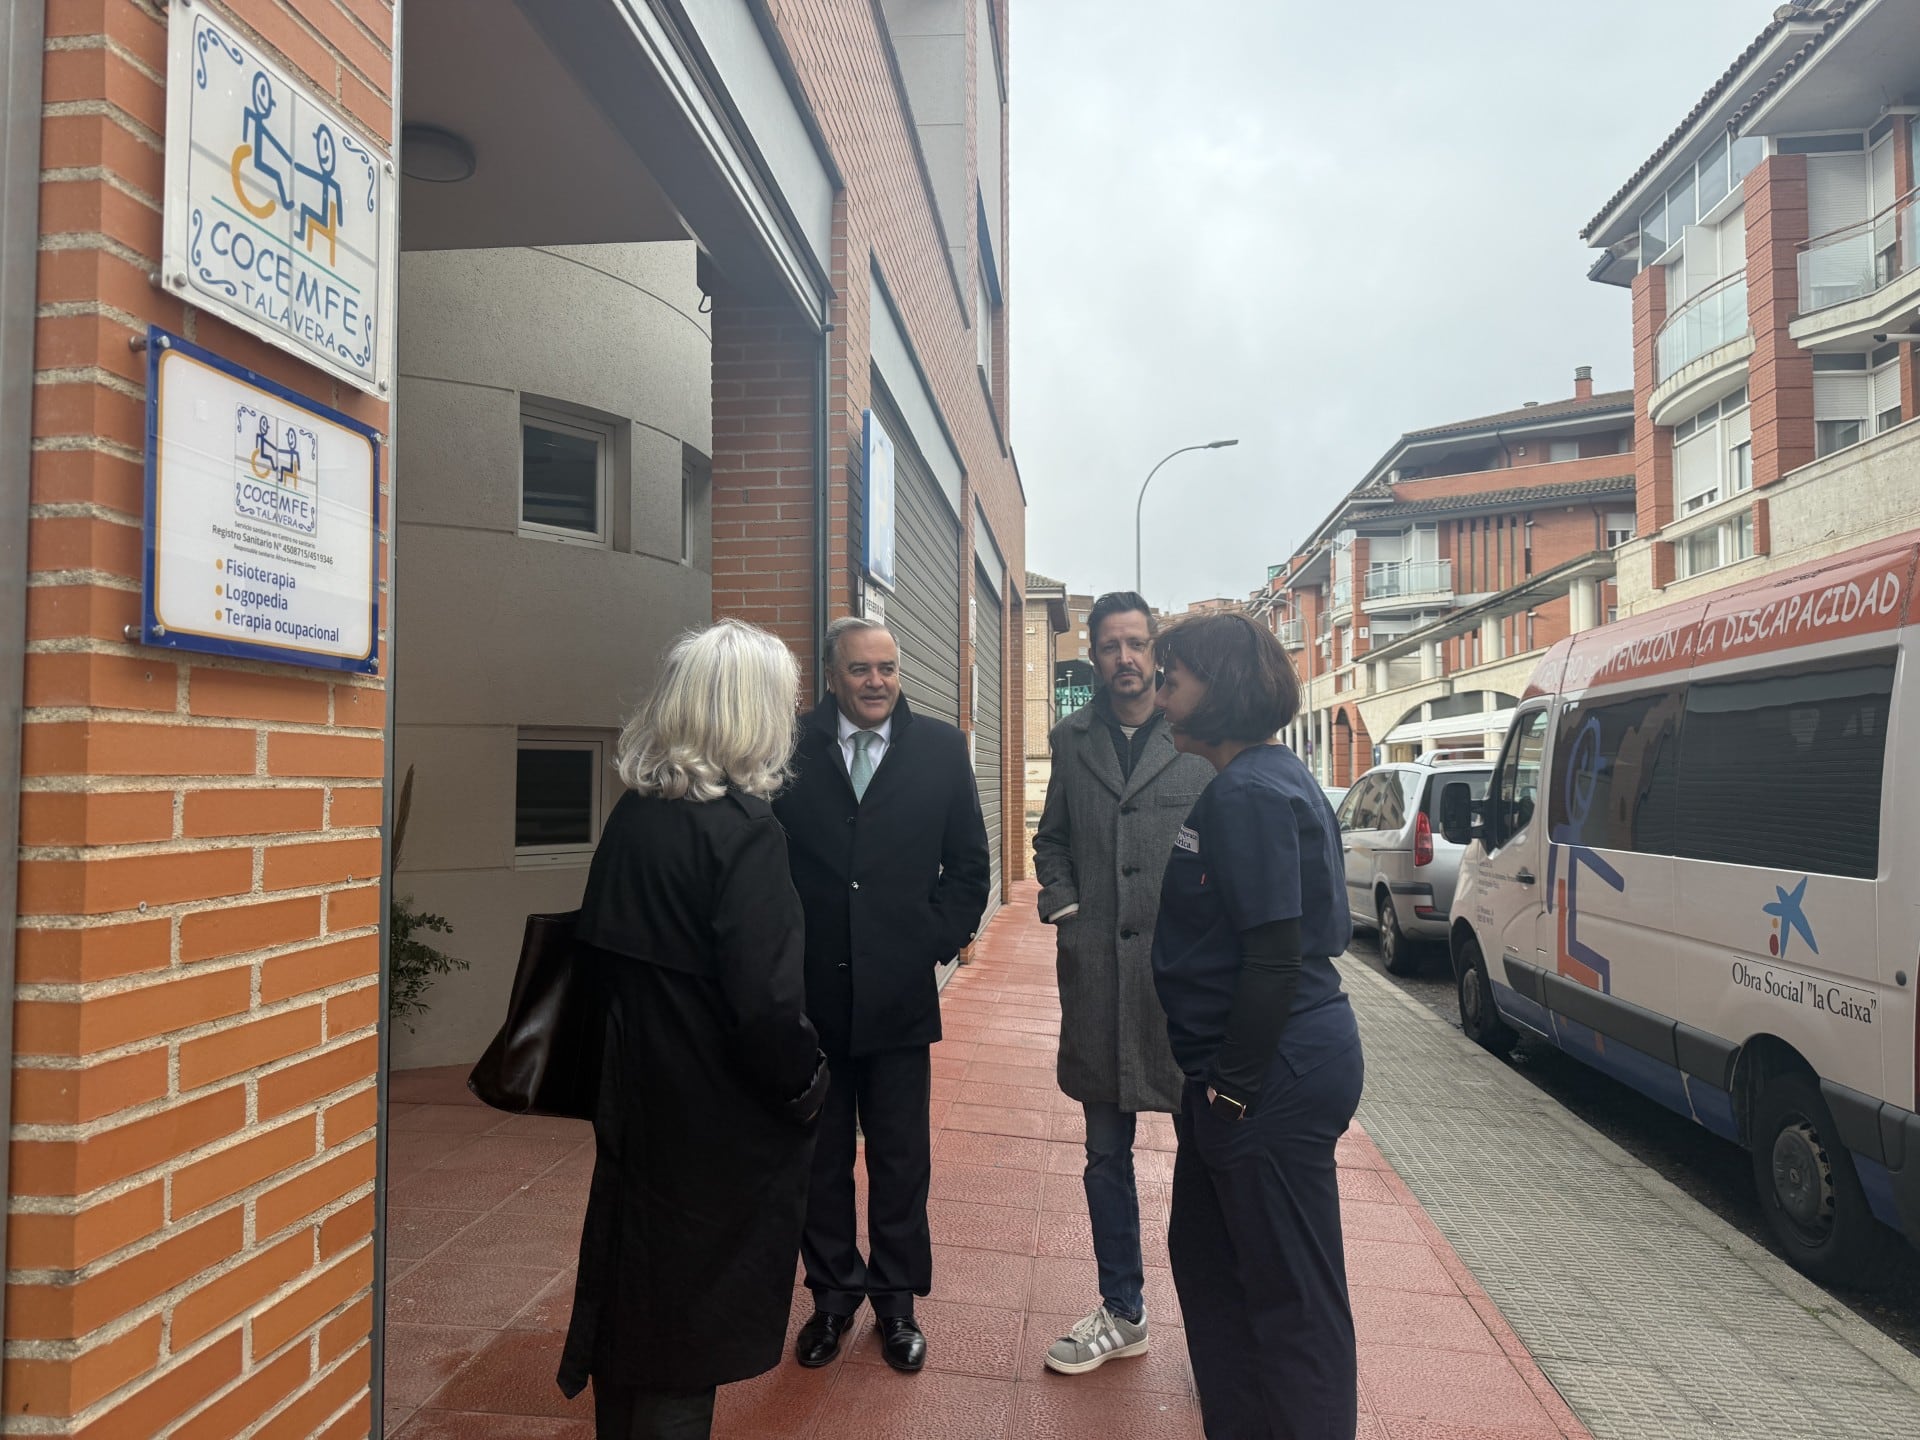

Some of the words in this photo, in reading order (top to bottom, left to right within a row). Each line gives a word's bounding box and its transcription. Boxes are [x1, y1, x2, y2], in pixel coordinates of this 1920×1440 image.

[210, 221, 359, 336] COCEMFE
[241, 281, 335, 350] TALAVERA
[243, 484, 309, 518] COCEMFE
[256, 506, 298, 528] TALAVERA
[212, 524, 242, 540] Registro
[242, 532, 273, 549] Sanitario
[273, 541, 282, 551] Nº
[234, 520, 252, 531] Servicio
[252, 525, 272, 537] sanitario
[226, 558, 296, 590] Fisioterapia
[226, 583, 288, 610] Logopedia
[225, 607, 272, 633] Terapia
[274, 619, 339, 642] ocupacional
[1599, 622, 1680, 677] ATENCIÓN
[1681, 630, 1693, 656] A
[1696, 624, 1716, 655] LA
[1721, 571, 1900, 650] DISCAPACIDAD
[1732, 962, 1761, 992] Obra
[1764, 971, 1804, 1004] Social
